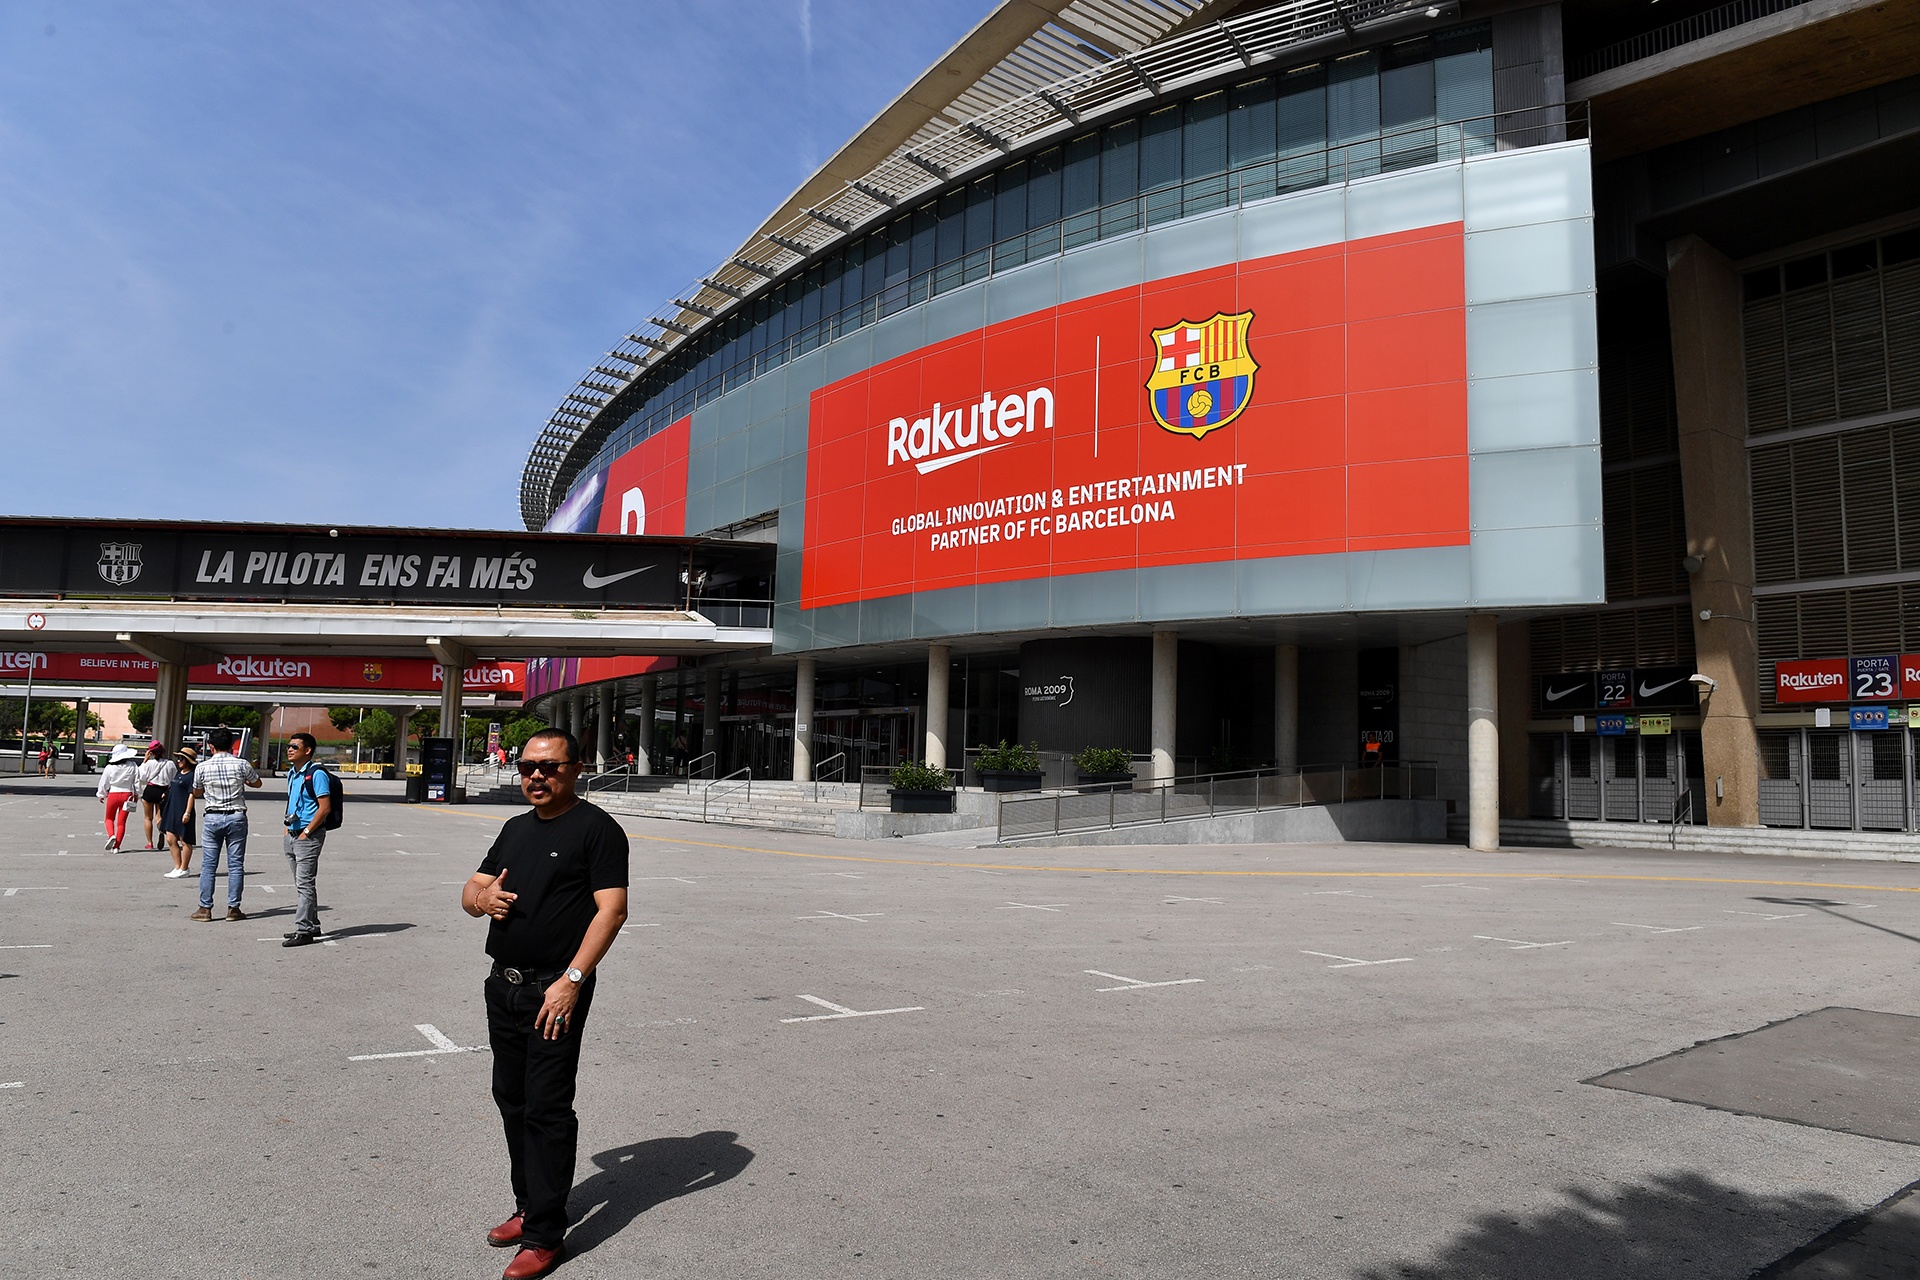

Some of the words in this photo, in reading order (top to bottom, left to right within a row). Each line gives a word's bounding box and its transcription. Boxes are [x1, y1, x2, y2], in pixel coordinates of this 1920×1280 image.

[1180, 364, 1220, 384] FCB
[887, 386, 1054, 467] Rakuten
[891, 510, 943, 536] GLOBAL
[945, 491, 1047, 525] INNOVATION
[1051, 488, 1064, 509] &
[1068, 463, 1248, 506] ENTERTAINMENT
[930, 523, 1001, 552] PARTNER
[1004, 519, 1027, 541] OF
[1030, 516, 1051, 537] FC
[1055, 500, 1176, 534] BARCELONA
[195, 550, 235, 583] LA
[242, 551, 346, 586] PILOTA
[359, 554, 421, 587] ENS
[425, 555, 461, 588] FA
[468, 551, 537, 590] MÉS
[80, 658, 118, 668] BELIEVE
[120, 659, 130, 668] IN
[131, 660, 150, 669] THE
[216, 655, 311, 678] Rakuten
[1856, 658, 1890, 668] PORTA
[1601, 672, 1626, 681] PORTA
[1780, 672, 1843, 688] Rakuten
[1856, 672, 1893, 697] 23
[1024, 686, 1043, 696] ROMA
[1043, 684, 1067, 695] 2009
[1603, 684, 1626, 701] 22
[1361, 730, 1383, 743] POTA
[1383, 730, 1394, 743] 20
